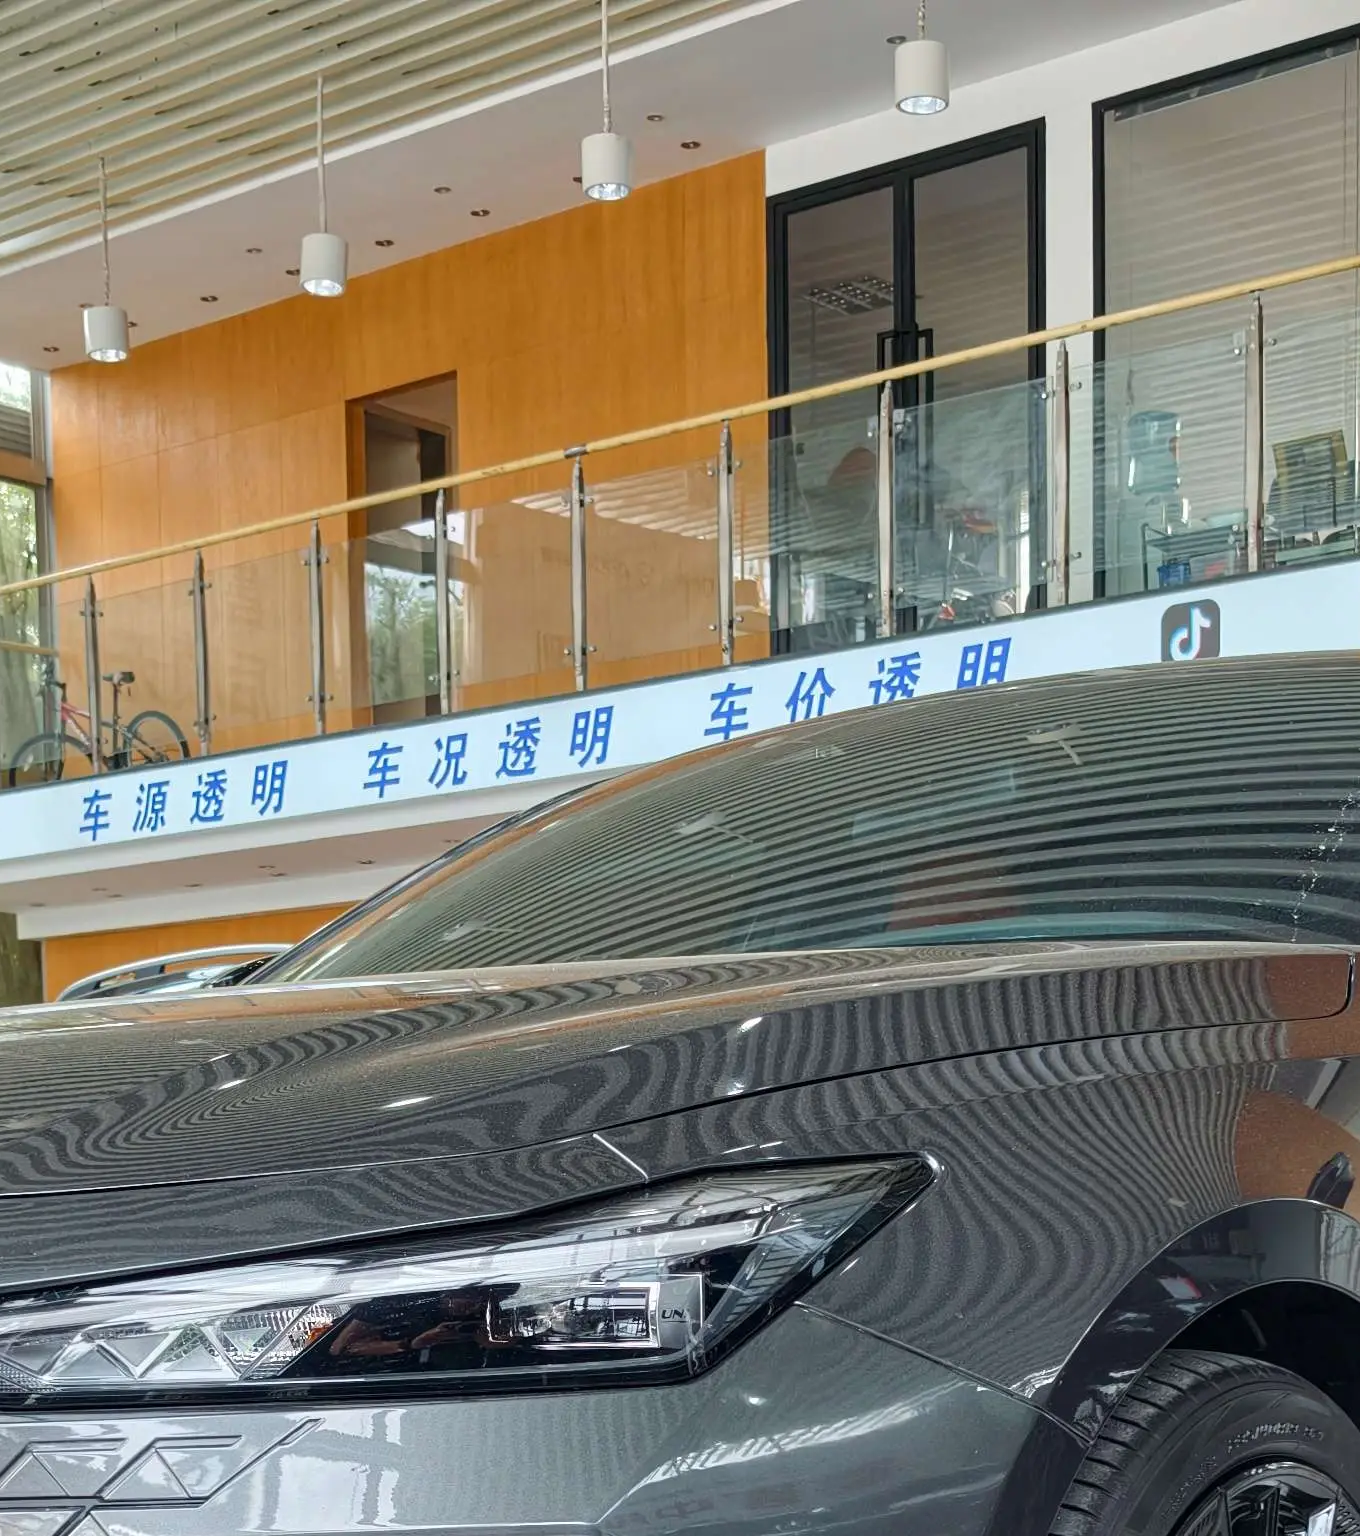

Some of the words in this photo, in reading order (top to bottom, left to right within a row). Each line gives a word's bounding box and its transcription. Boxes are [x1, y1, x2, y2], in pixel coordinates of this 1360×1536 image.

[79, 760, 288, 842] 车源透明
[362, 706, 615, 798] 车况透明
[703, 637, 1012, 740] 车价透明
